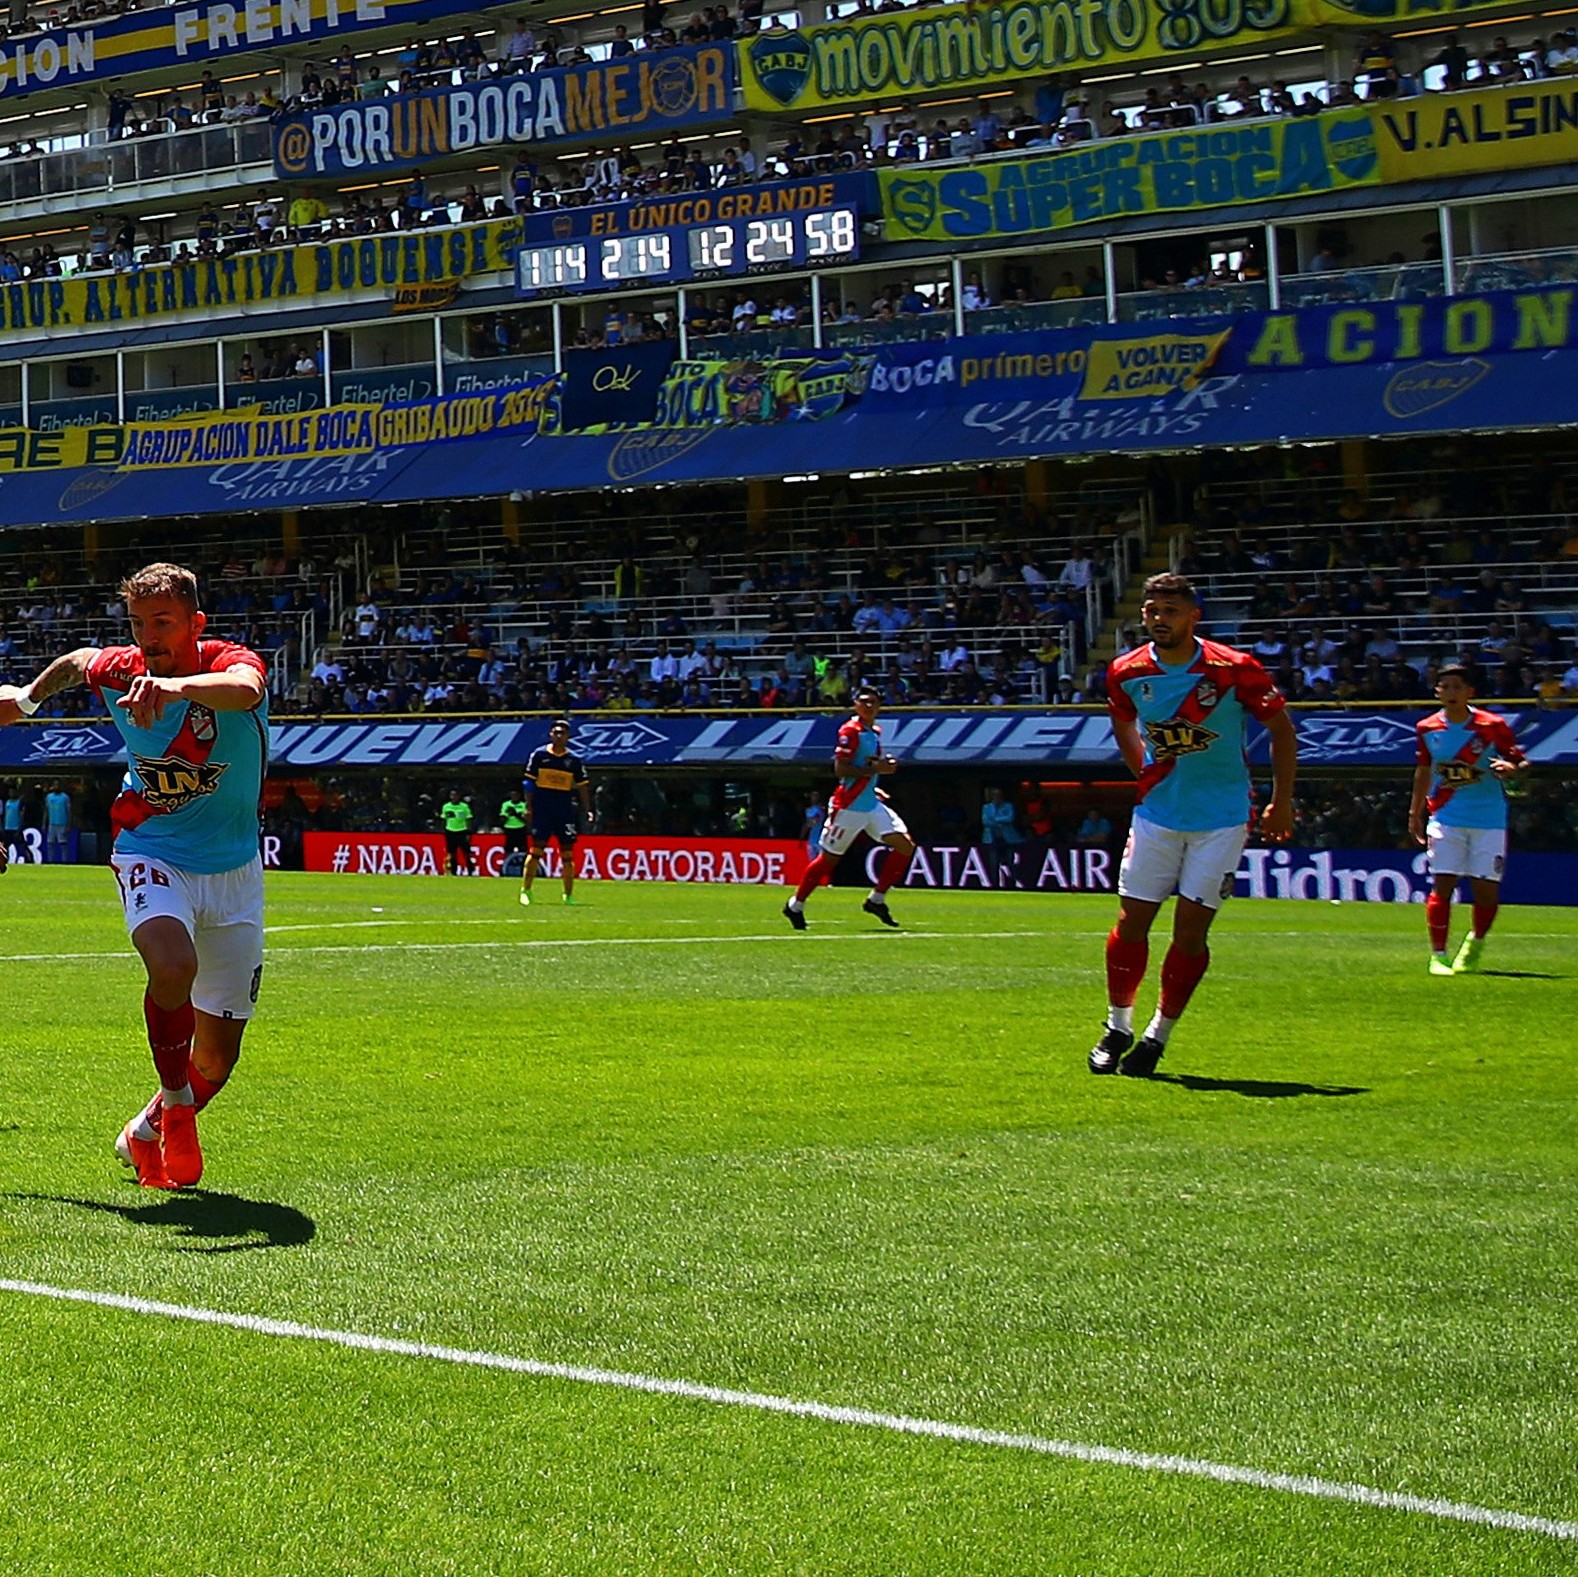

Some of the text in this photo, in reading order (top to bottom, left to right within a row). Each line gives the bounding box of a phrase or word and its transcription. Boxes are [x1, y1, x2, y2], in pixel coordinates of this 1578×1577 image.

[938, 118, 1333, 238] SUPER BOCA
[997, 124, 1273, 190] AGRUPACION
[590, 183, 836, 236] EL ÚNICO GRANDE
[601, 235, 671, 280] 214
[699, 225, 735, 267] 12
[746, 218, 794, 264] 24
[804, 210, 854, 256] 58
[84, 249, 297, 322] ALTERNATIVA
[315, 224, 490, 292] BOQUENSE
[1248, 287, 1575, 367] ACION
[871, 353, 955, 394] BOCA
[1115, 341, 1209, 370] VOLVER
[341, 379, 414, 405] Fibertel
[122, 421, 247, 466] AGRUPACION
[255, 414, 309, 457] DALE
[314, 407, 373, 452] BOCA
[997, 412, 1209, 446] AIRWAYS
[224, 472, 377, 501] AIRWAYS
[673, 719, 817, 761] LA
[158, 769, 199, 795] LN
[357, 845, 433, 876] NADA
[579, 848, 603, 880] A
[607, 849, 786, 886] GATORADE
